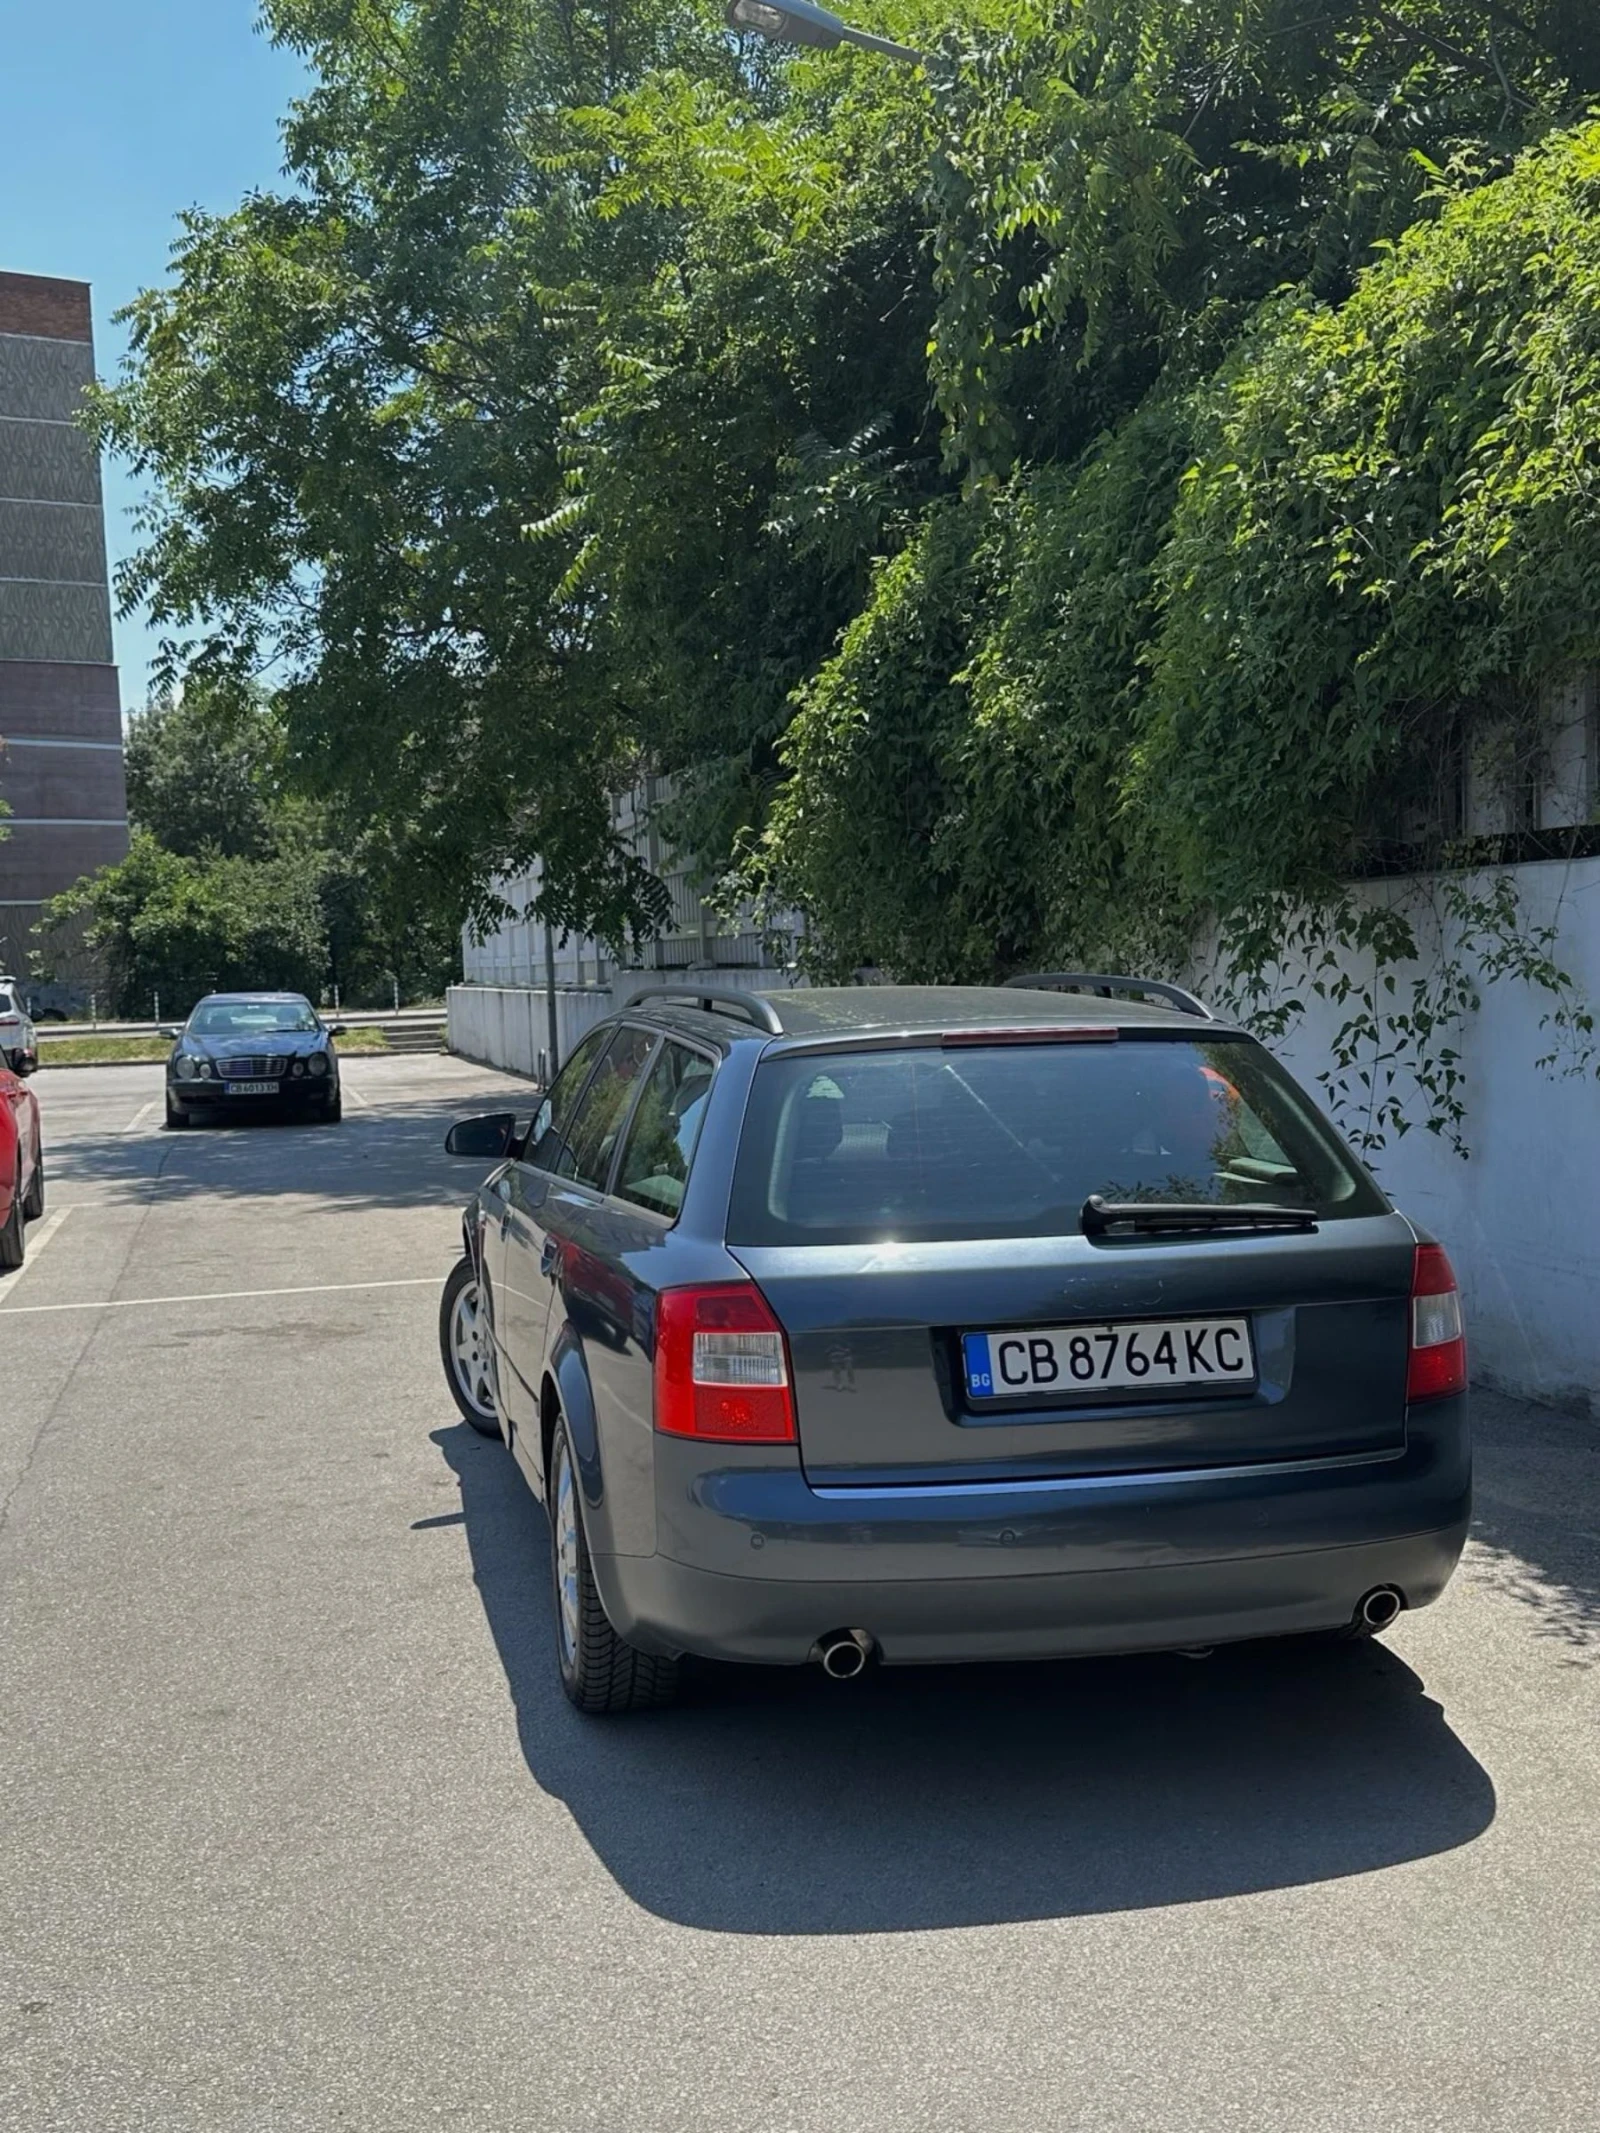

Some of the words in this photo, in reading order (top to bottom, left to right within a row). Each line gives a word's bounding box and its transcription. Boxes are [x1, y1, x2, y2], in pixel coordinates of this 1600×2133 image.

[998, 1339, 1059, 1385] CB
[1069, 1331, 1178, 1380] 8764
[1184, 1327, 1244, 1374] KC
[971, 1373, 990, 1387] BG
